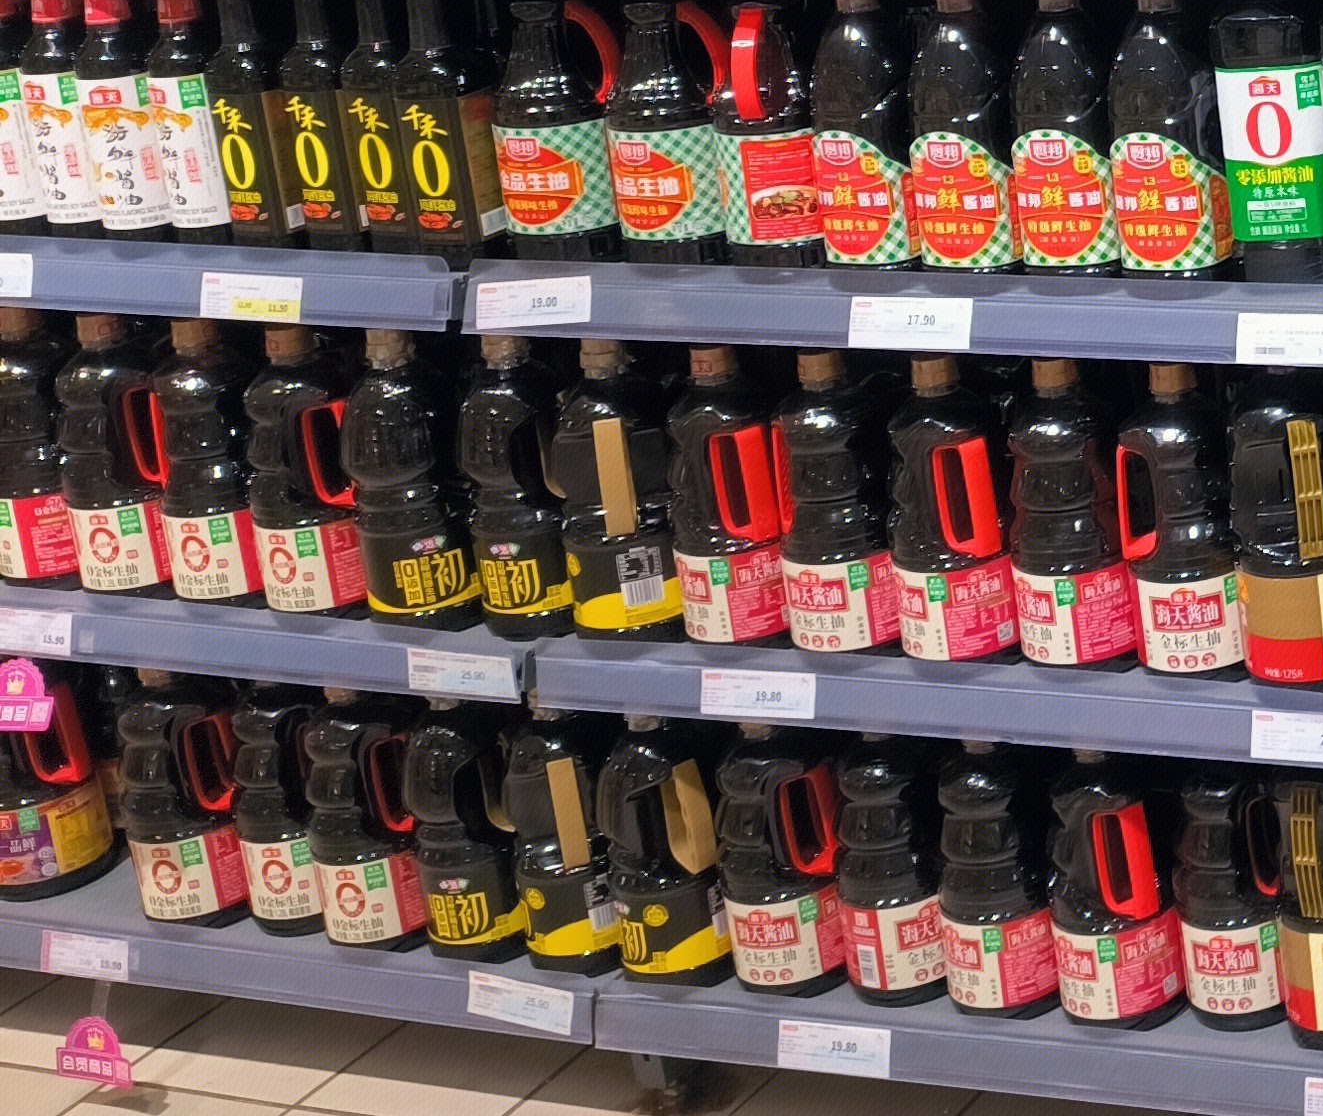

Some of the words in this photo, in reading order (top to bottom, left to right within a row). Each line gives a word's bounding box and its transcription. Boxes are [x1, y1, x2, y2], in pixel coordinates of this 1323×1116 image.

[402, 102, 447, 140] 千禾
[1245, 102, 1292, 160] 0
[294, 131, 330, 188] 0
[412, 140, 450, 198] 0
[530, 296, 558, 309] 19.00
[906, 314, 936, 326] 17.90
[1154, 604, 1222, 630] 海天酱油
[754, 690, 782, 703] 19.80
